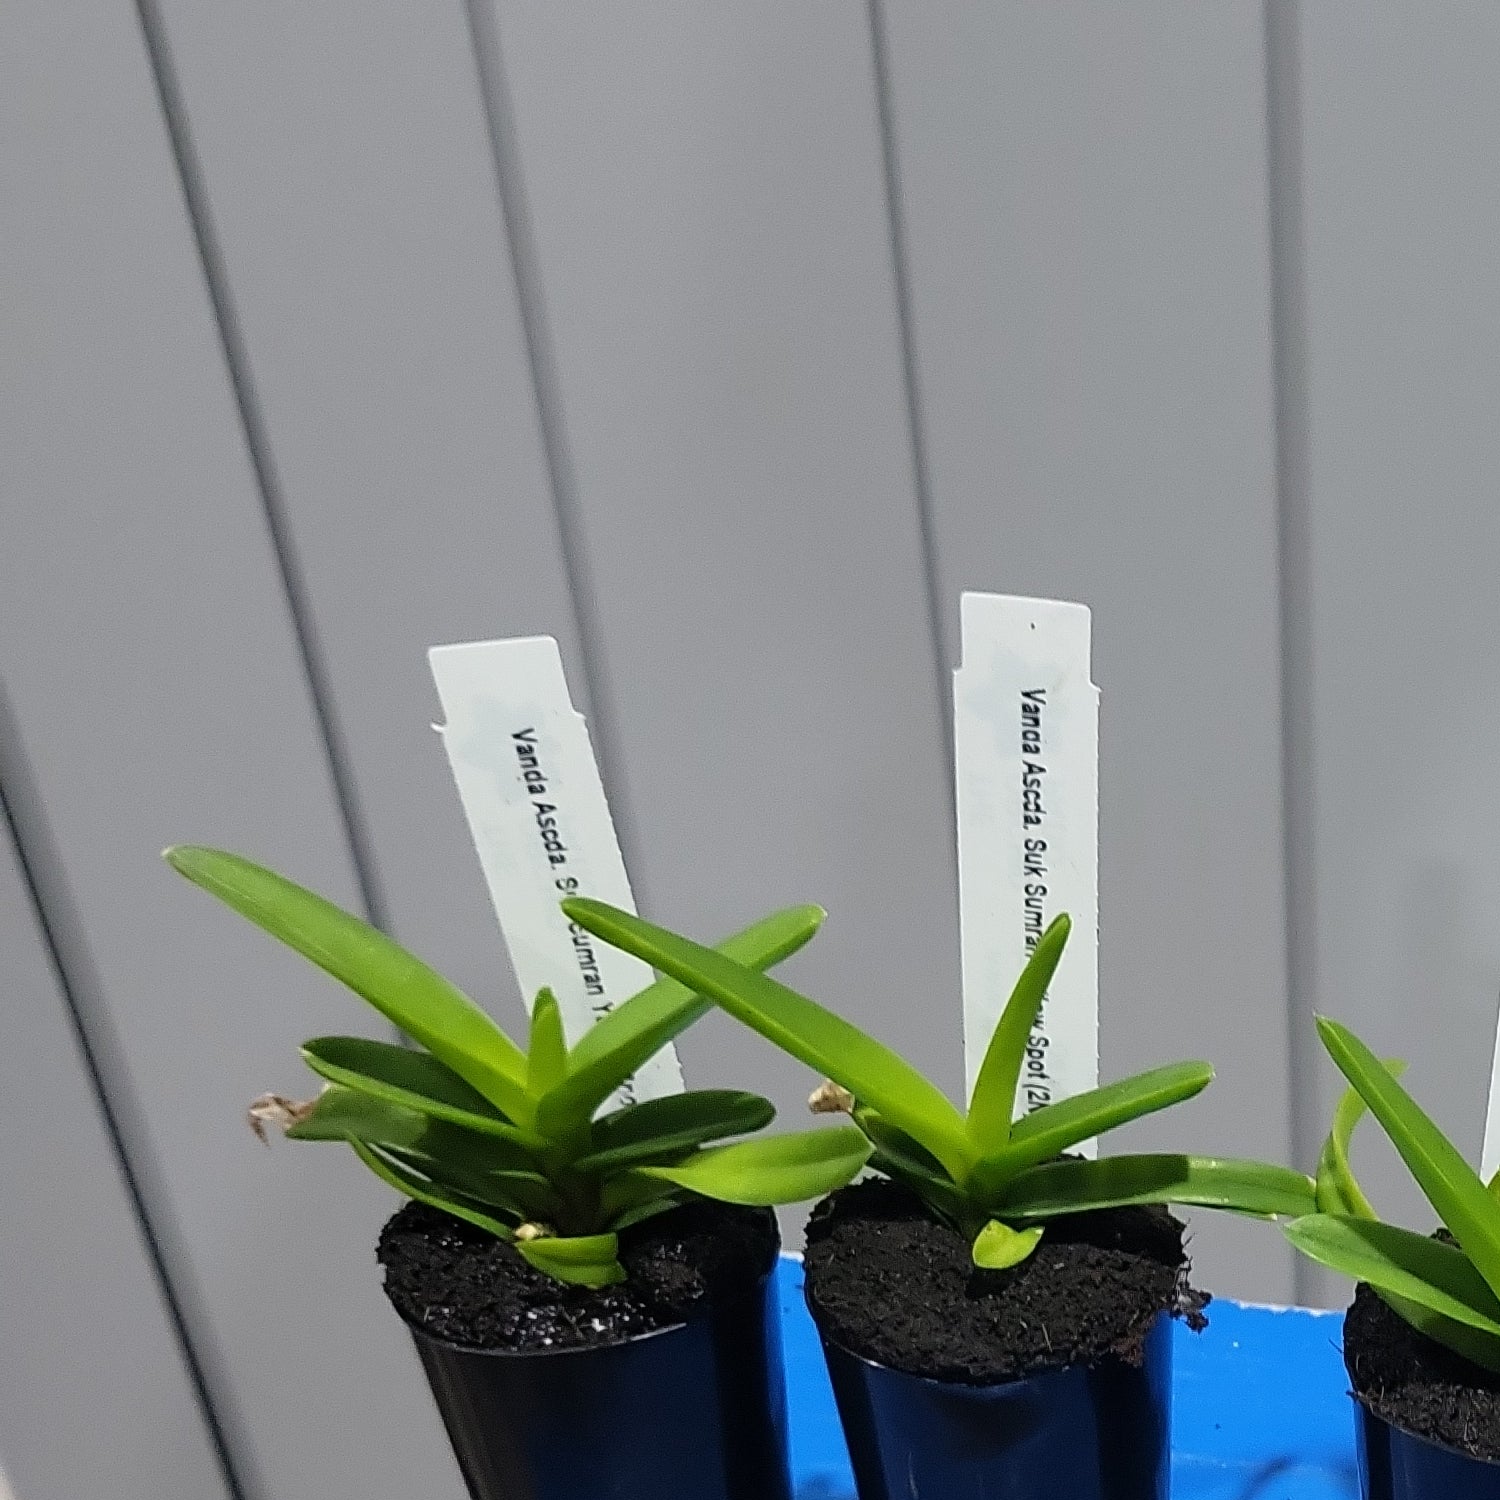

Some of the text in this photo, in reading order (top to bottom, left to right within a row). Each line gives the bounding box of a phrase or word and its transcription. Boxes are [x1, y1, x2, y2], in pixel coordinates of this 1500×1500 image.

[1021, 688, 1047, 754] Vanda
[511, 728, 548, 794] Vanda
[532, 801, 568, 870] Ascda.
[1022, 760, 1047, 830] Ascda.
[1023, 838, 1048, 878] Suk
[1025, 1035, 1050, 1079] Spot
